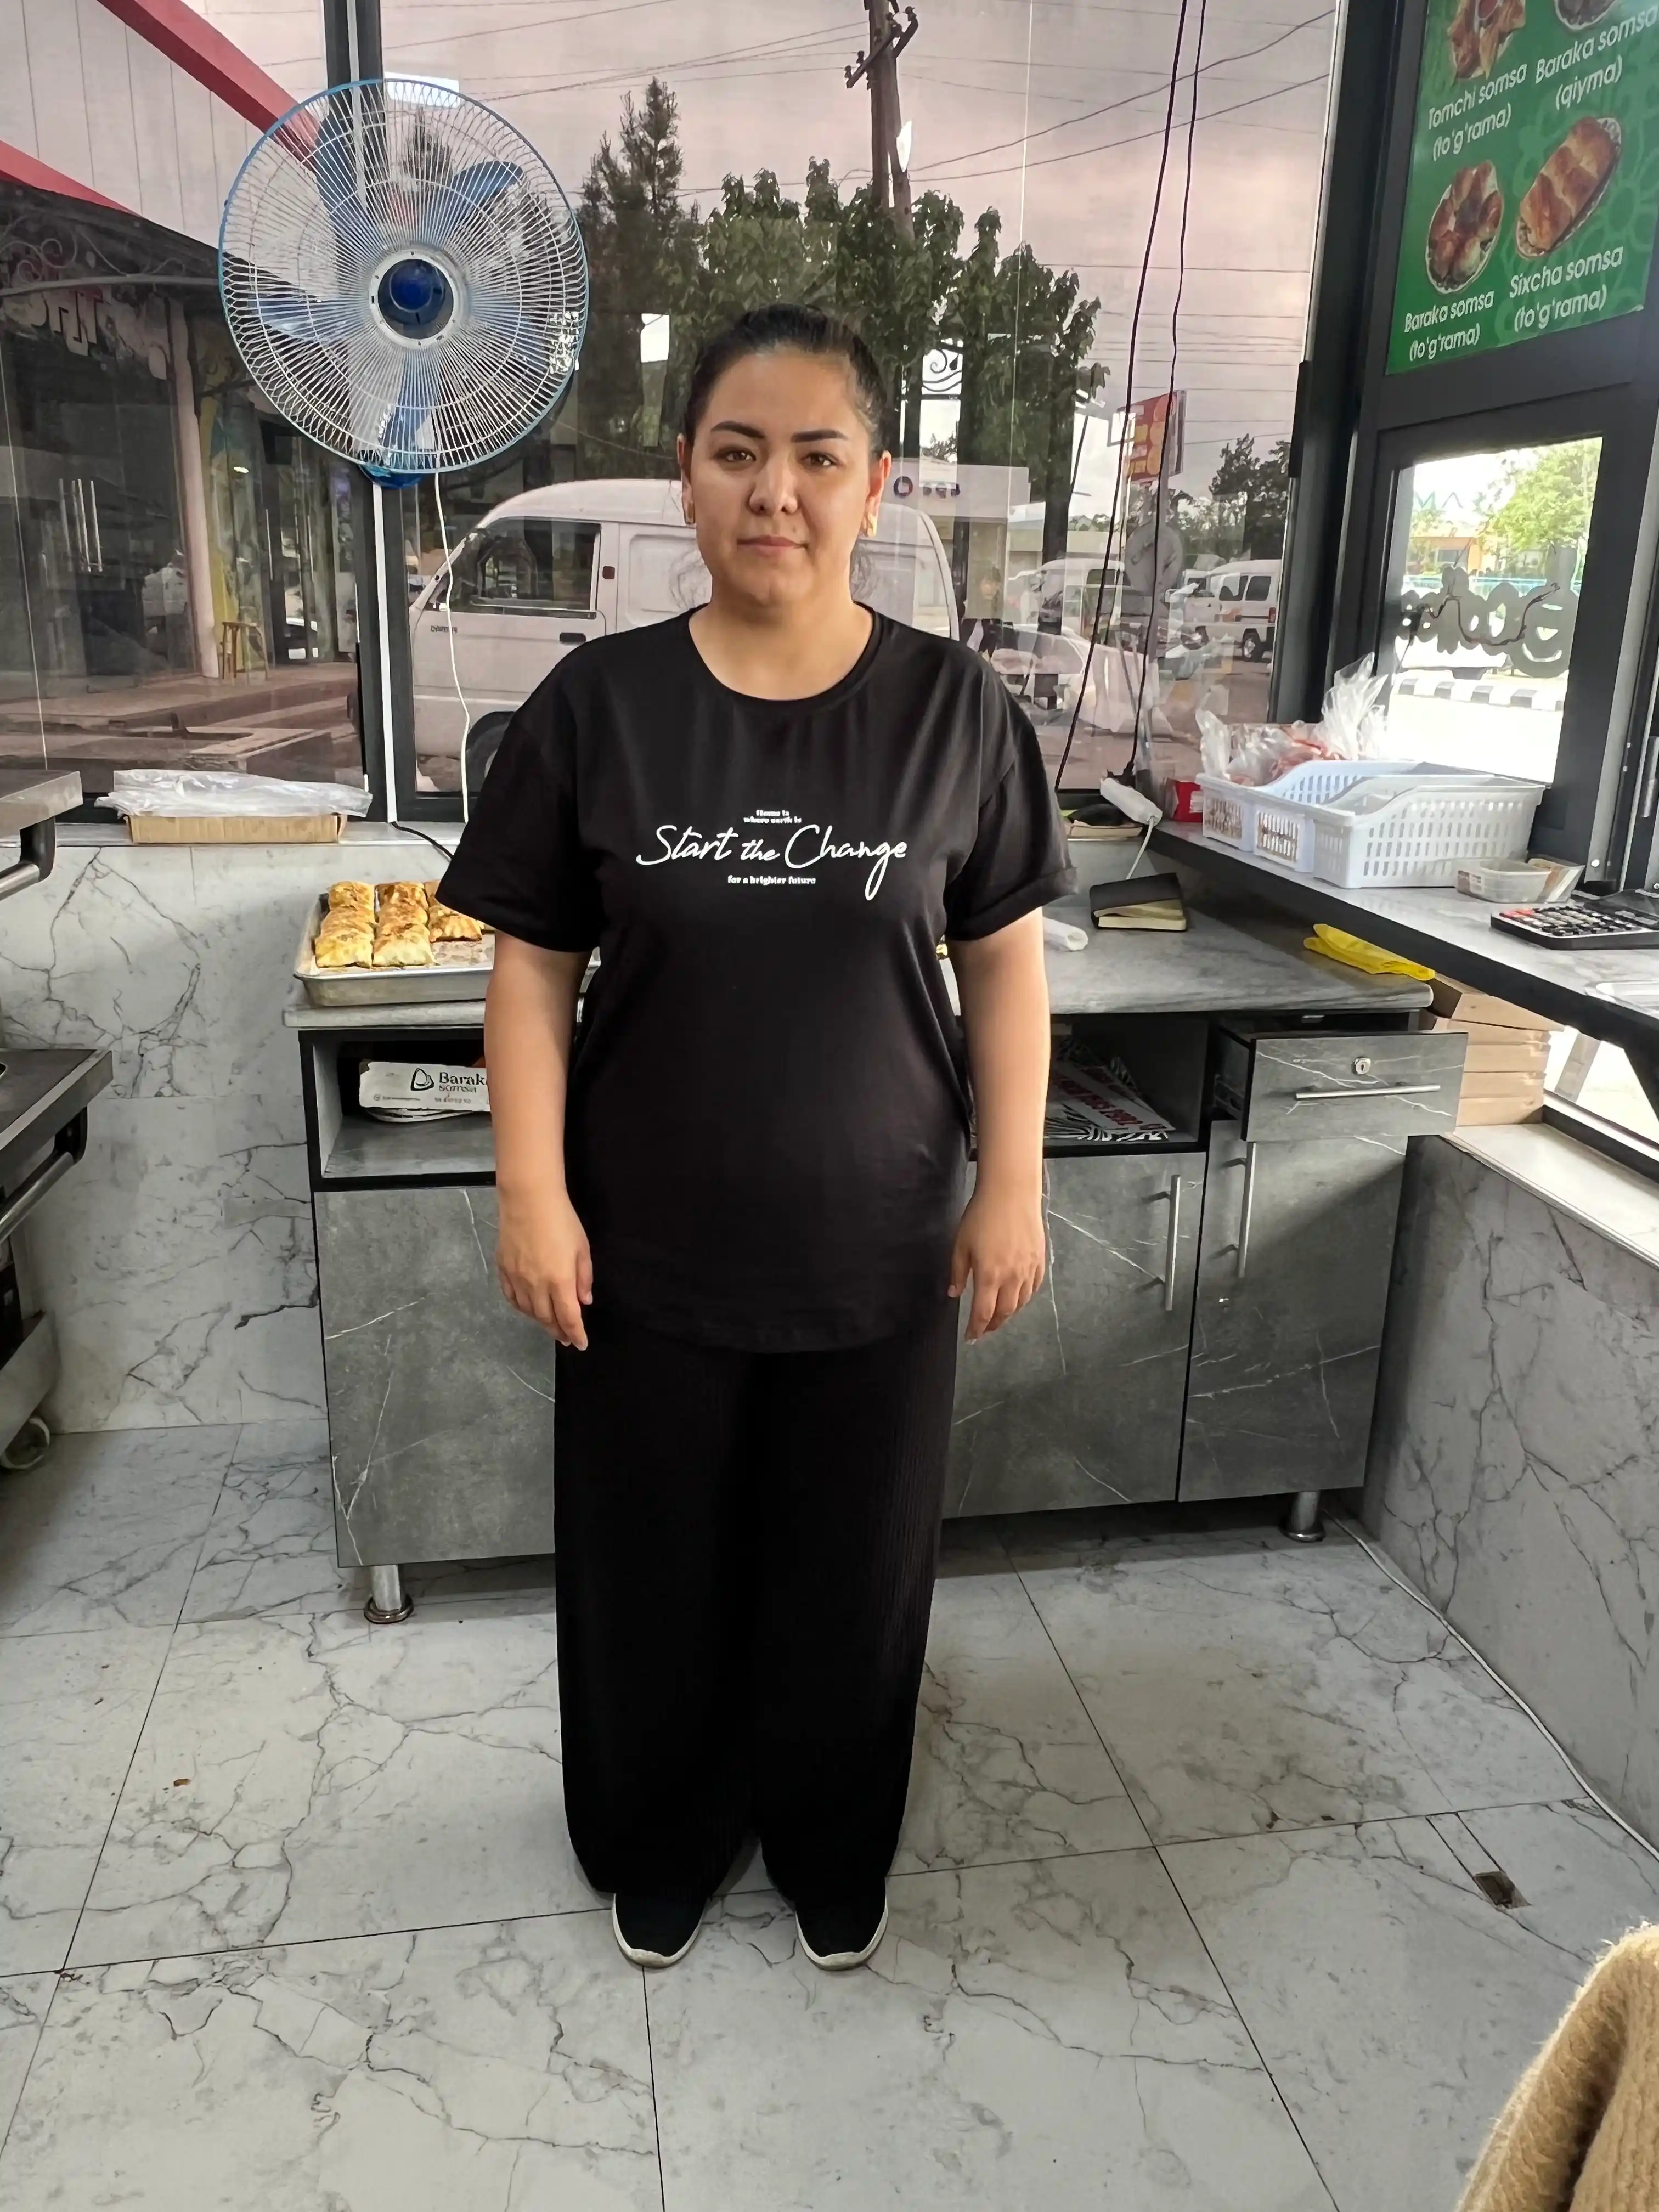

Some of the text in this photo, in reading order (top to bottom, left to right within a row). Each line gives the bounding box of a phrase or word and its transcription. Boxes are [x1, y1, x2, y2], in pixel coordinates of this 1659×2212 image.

[1536, 5, 1658, 84] Baraka somsa
[1429, 64, 1527, 130] Tomchi somsa
[1556, 54, 1623, 110] (qiyma)
[1509, 246, 1624, 298] Sixcha somsa
[1404, 290, 1494, 332] Baraka somsa
[636, 823, 909, 901] Start the Change
[727, 874, 741, 884] for
[750, 875, 787, 886] brighter
[439, 1071, 487, 1086] Barak
